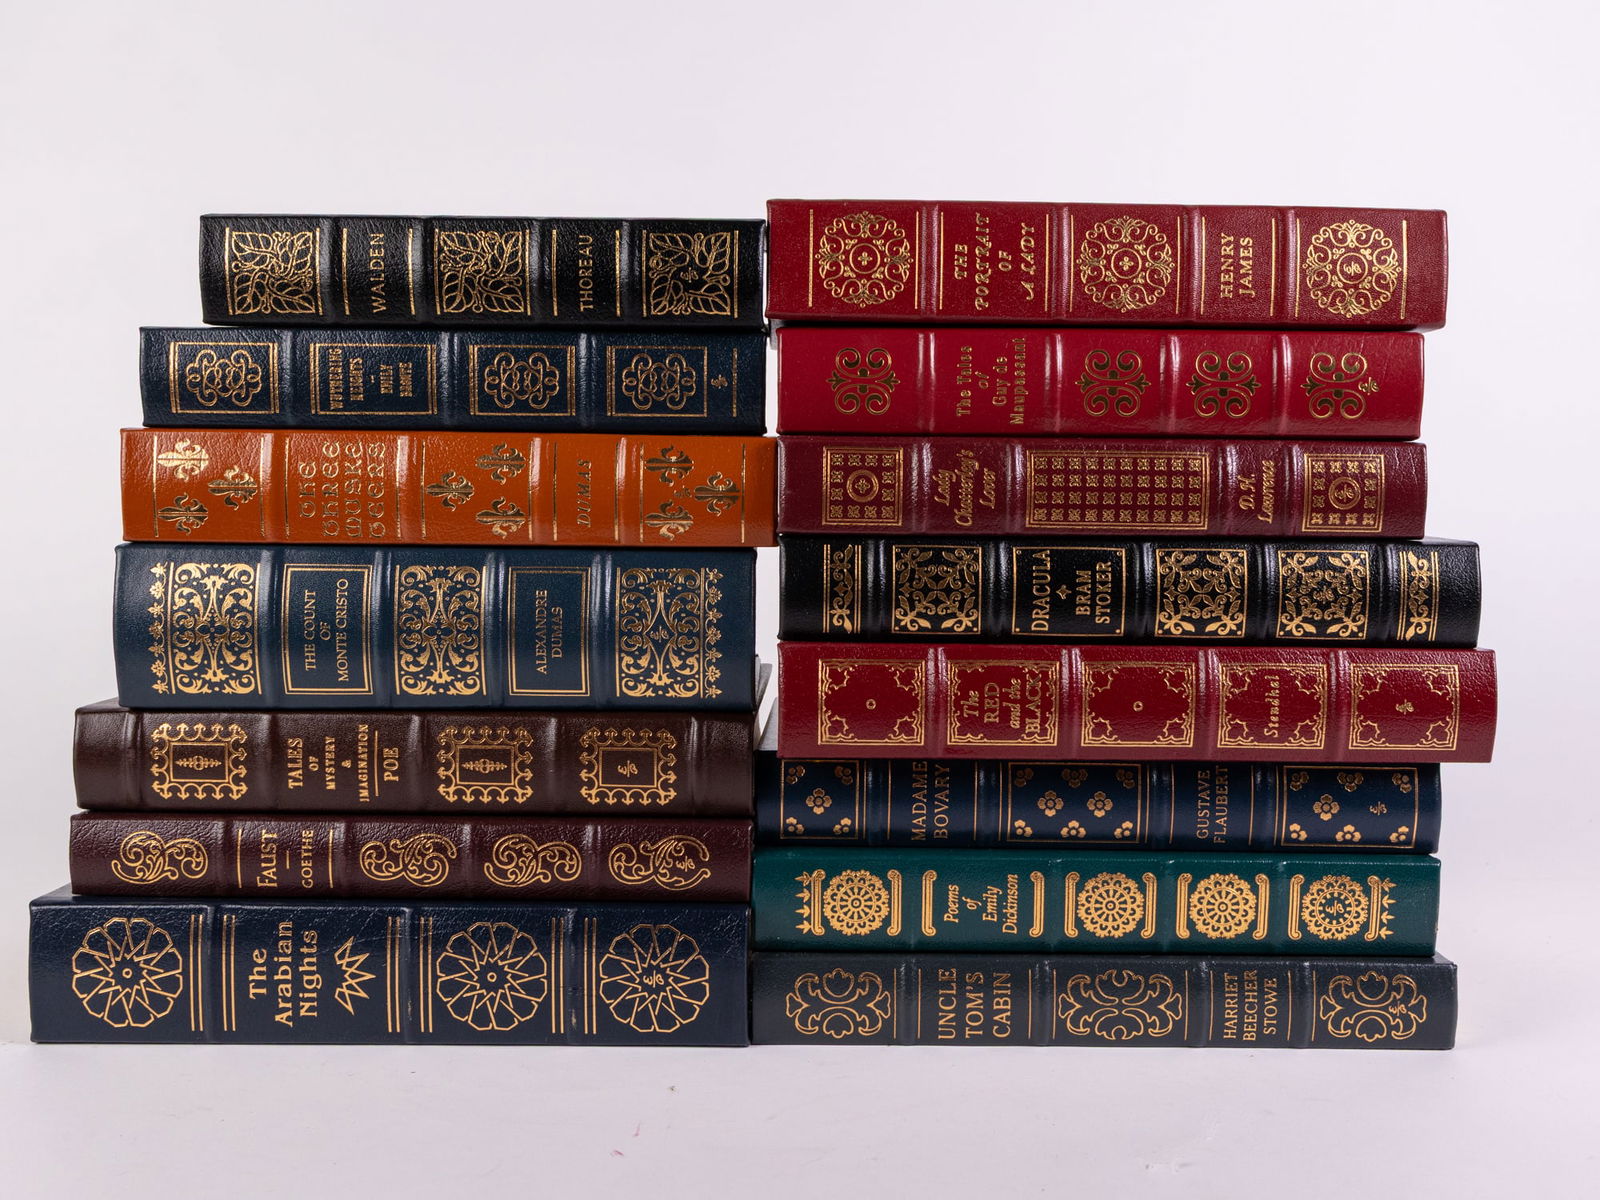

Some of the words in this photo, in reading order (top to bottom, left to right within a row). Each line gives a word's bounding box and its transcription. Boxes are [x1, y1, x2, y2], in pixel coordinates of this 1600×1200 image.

[369, 233, 385, 313] WALDEN
[578, 234, 594, 312] THOREAU
[954, 243, 968, 280] THE
[974, 212, 992, 311] PORTRAIT
[998, 250, 1012, 272] OF
[1020, 222, 1036, 275] LADY
[1220, 232, 1235, 299] HENRY
[1239, 236, 1256, 298] JAMES
[1020, 281, 1035, 301] A
[328, 348, 344, 410] WUTHERING
[349, 357, 364, 401] HEIGHTS
[956, 346, 972, 385] Tales
[975, 371, 989, 390] of
[992, 356, 1008, 374] de
[992, 378, 1011, 406] Guy
[1009, 338, 1029, 424] Maupassant
[955, 390, 972, 416] The
[576, 459, 592, 528] DUMAS
[932, 469, 957, 507] Lady
[953, 449, 979, 526] Chatterley's
[979, 467, 996, 510] Lover
[1257, 460, 1276, 525] Lawrence
[303, 589, 316, 641] COUNT
[335, 578, 349, 629] CRISTO
[1030, 549, 1052, 632] DRACULA
[1075, 570, 1092, 616] BRAM
[1094, 560, 1113, 625] STOKER
[304, 643, 316, 671] THE
[319, 621, 331, 641] OF
[335, 631, 349, 682] MONTE
[535, 589, 548, 675] ALEXANDRE
[551, 605, 563, 659] DUMAS
[960, 690, 980, 718] The
[983, 682, 1000, 724] RED
[1002, 677, 1021, 699] the
[1002, 701, 1021, 729] and
[1024, 673, 1042, 734] BLACK
[1263, 675, 1280, 738] Stendhal
[287, 737, 303, 790] TALES
[308, 755, 320, 772] OF
[325, 736, 336, 790] MYSTERY
[341, 759, 352, 769] &
[357, 724, 370, 802] IMAGINATION
[382, 747, 400, 782] POE
[911, 761, 929, 840] MADAME
[933, 764, 950, 839] BOVARY
[1196, 770, 1211, 839] GUSTAVE
[1213, 765, 1229, 844] FLAUBERT
[256, 829, 278, 888] FAUST
[300, 830, 314, 889] GOETHE
[943, 884, 960, 923] Poems
[961, 896, 982, 911] of
[982, 886, 1003, 922] Emily
[1002, 874, 1019, 935] Dickinson
[248, 948, 268, 1000] The
[273, 920, 294, 1028] Arabian
[298, 930, 323, 1018] Nights
[937, 967, 957, 1040] UNCLE
[964, 971, 984, 1039] TOM'S
[992, 972, 1011, 1038] CABIN
[1223, 972, 1239, 1040] HARRIET
[1242, 969, 1258, 1041] BEECHER
[1263, 978, 1278, 1035] STOWE
